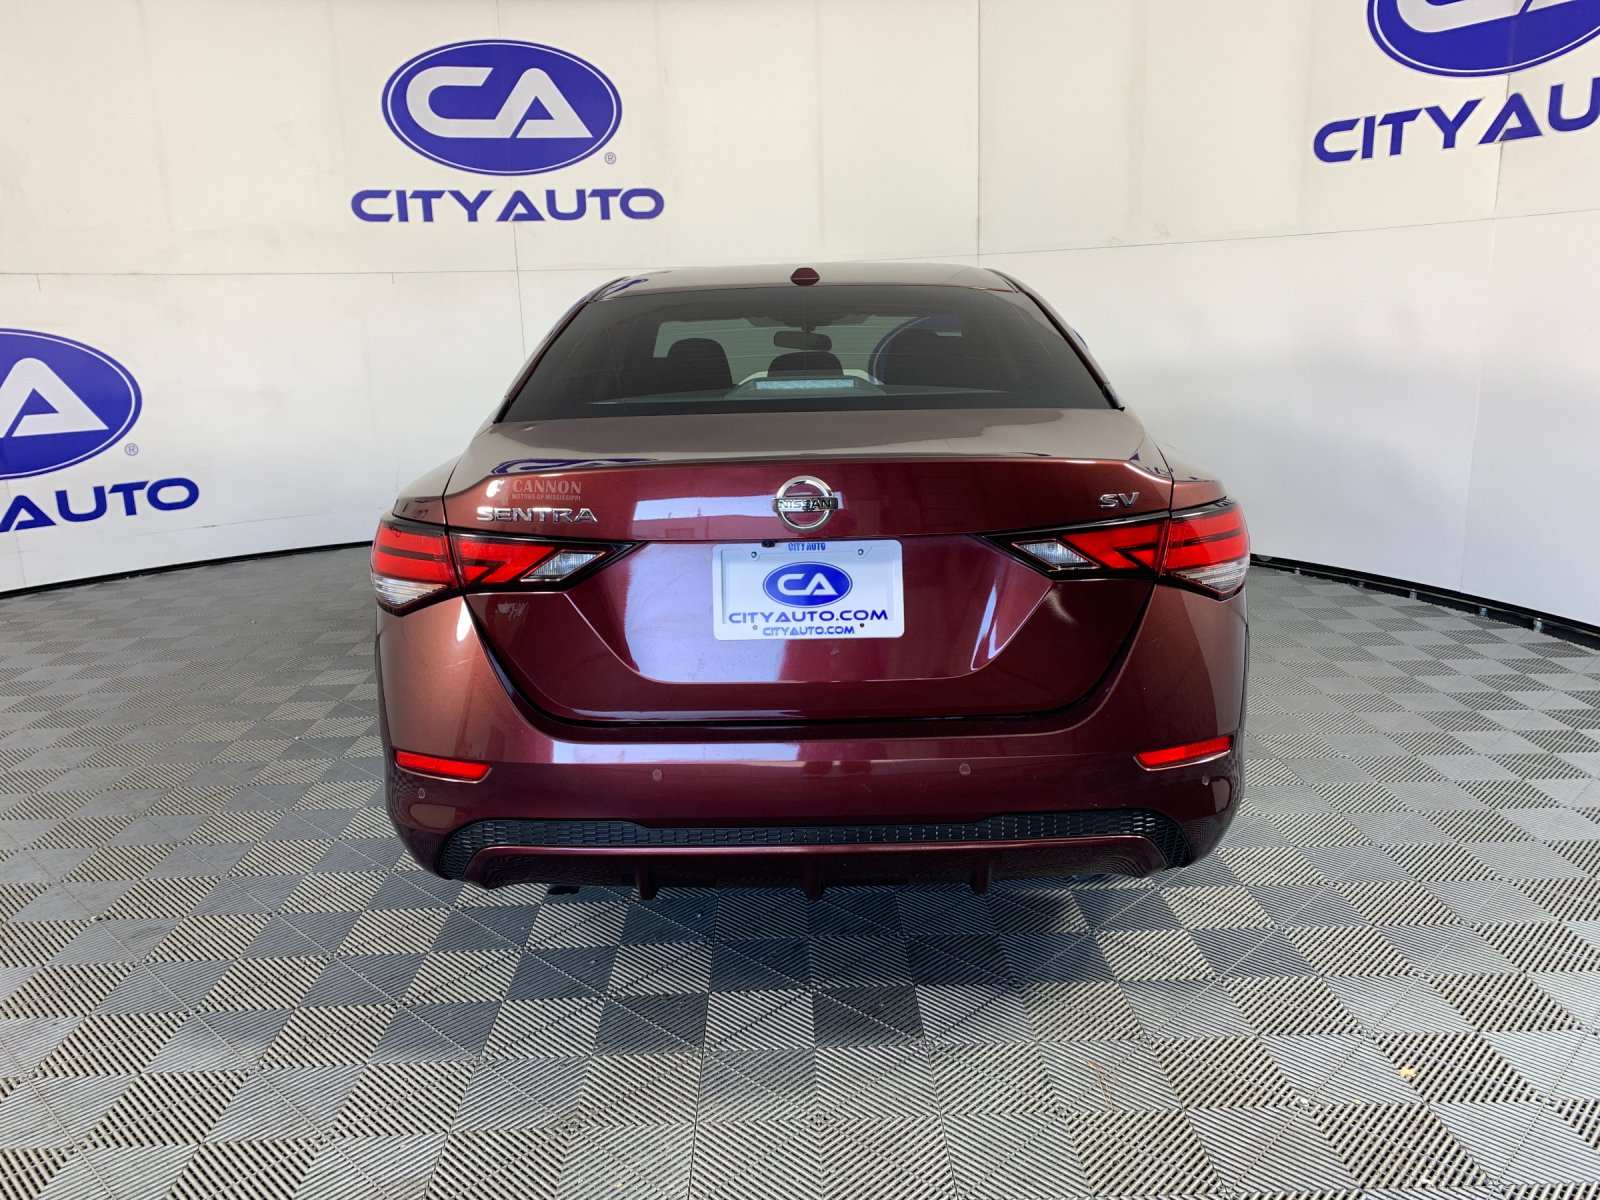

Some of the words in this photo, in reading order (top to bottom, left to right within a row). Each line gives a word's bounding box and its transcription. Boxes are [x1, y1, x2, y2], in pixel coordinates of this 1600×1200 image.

[406, 65, 594, 138] CA
[1313, 96, 1486, 163] CITY
[351, 189, 495, 222] CITY
[495, 188, 665, 222] AUTO
[512, 480, 582, 494] CANNON
[778, 499, 831, 509] NISSAN
[1100, 491, 1140, 508] SV
[476, 506, 598, 522] SENTRA
[788, 542, 805, 551] CITY
[806, 542, 826, 551] AUTO
[777, 572, 839, 596] CA
[728, 609, 889, 624] CITYAUTO.COM
[762, 625, 855, 637] CITYAUTO.COM
